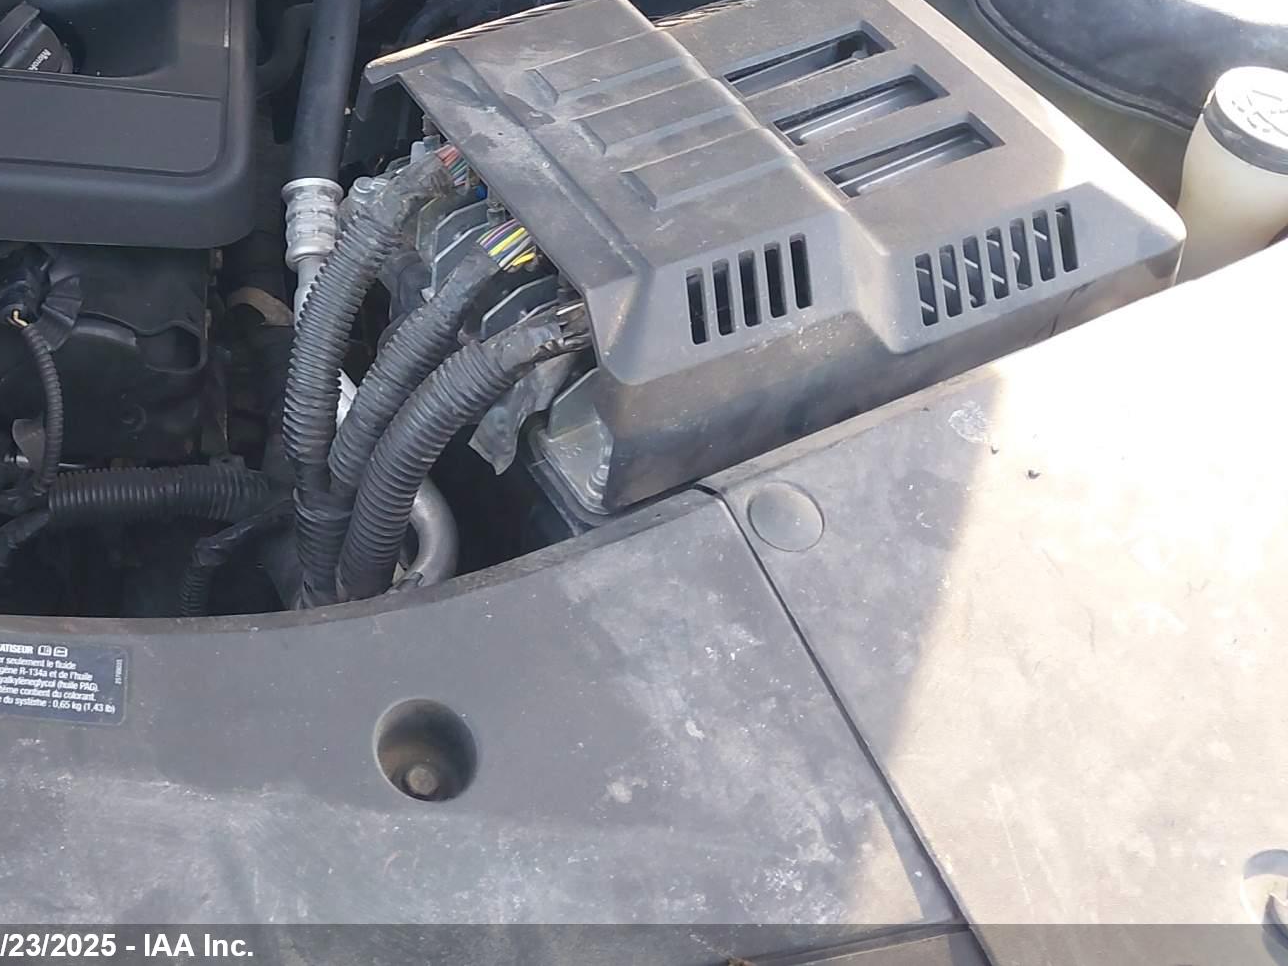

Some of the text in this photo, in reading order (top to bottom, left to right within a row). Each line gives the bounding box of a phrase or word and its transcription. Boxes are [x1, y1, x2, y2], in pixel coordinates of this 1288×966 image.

[6, 657, 45, 667] seulement
[20, 667, 48, 677] R-134a
[20, 687, 50, 697] contient
